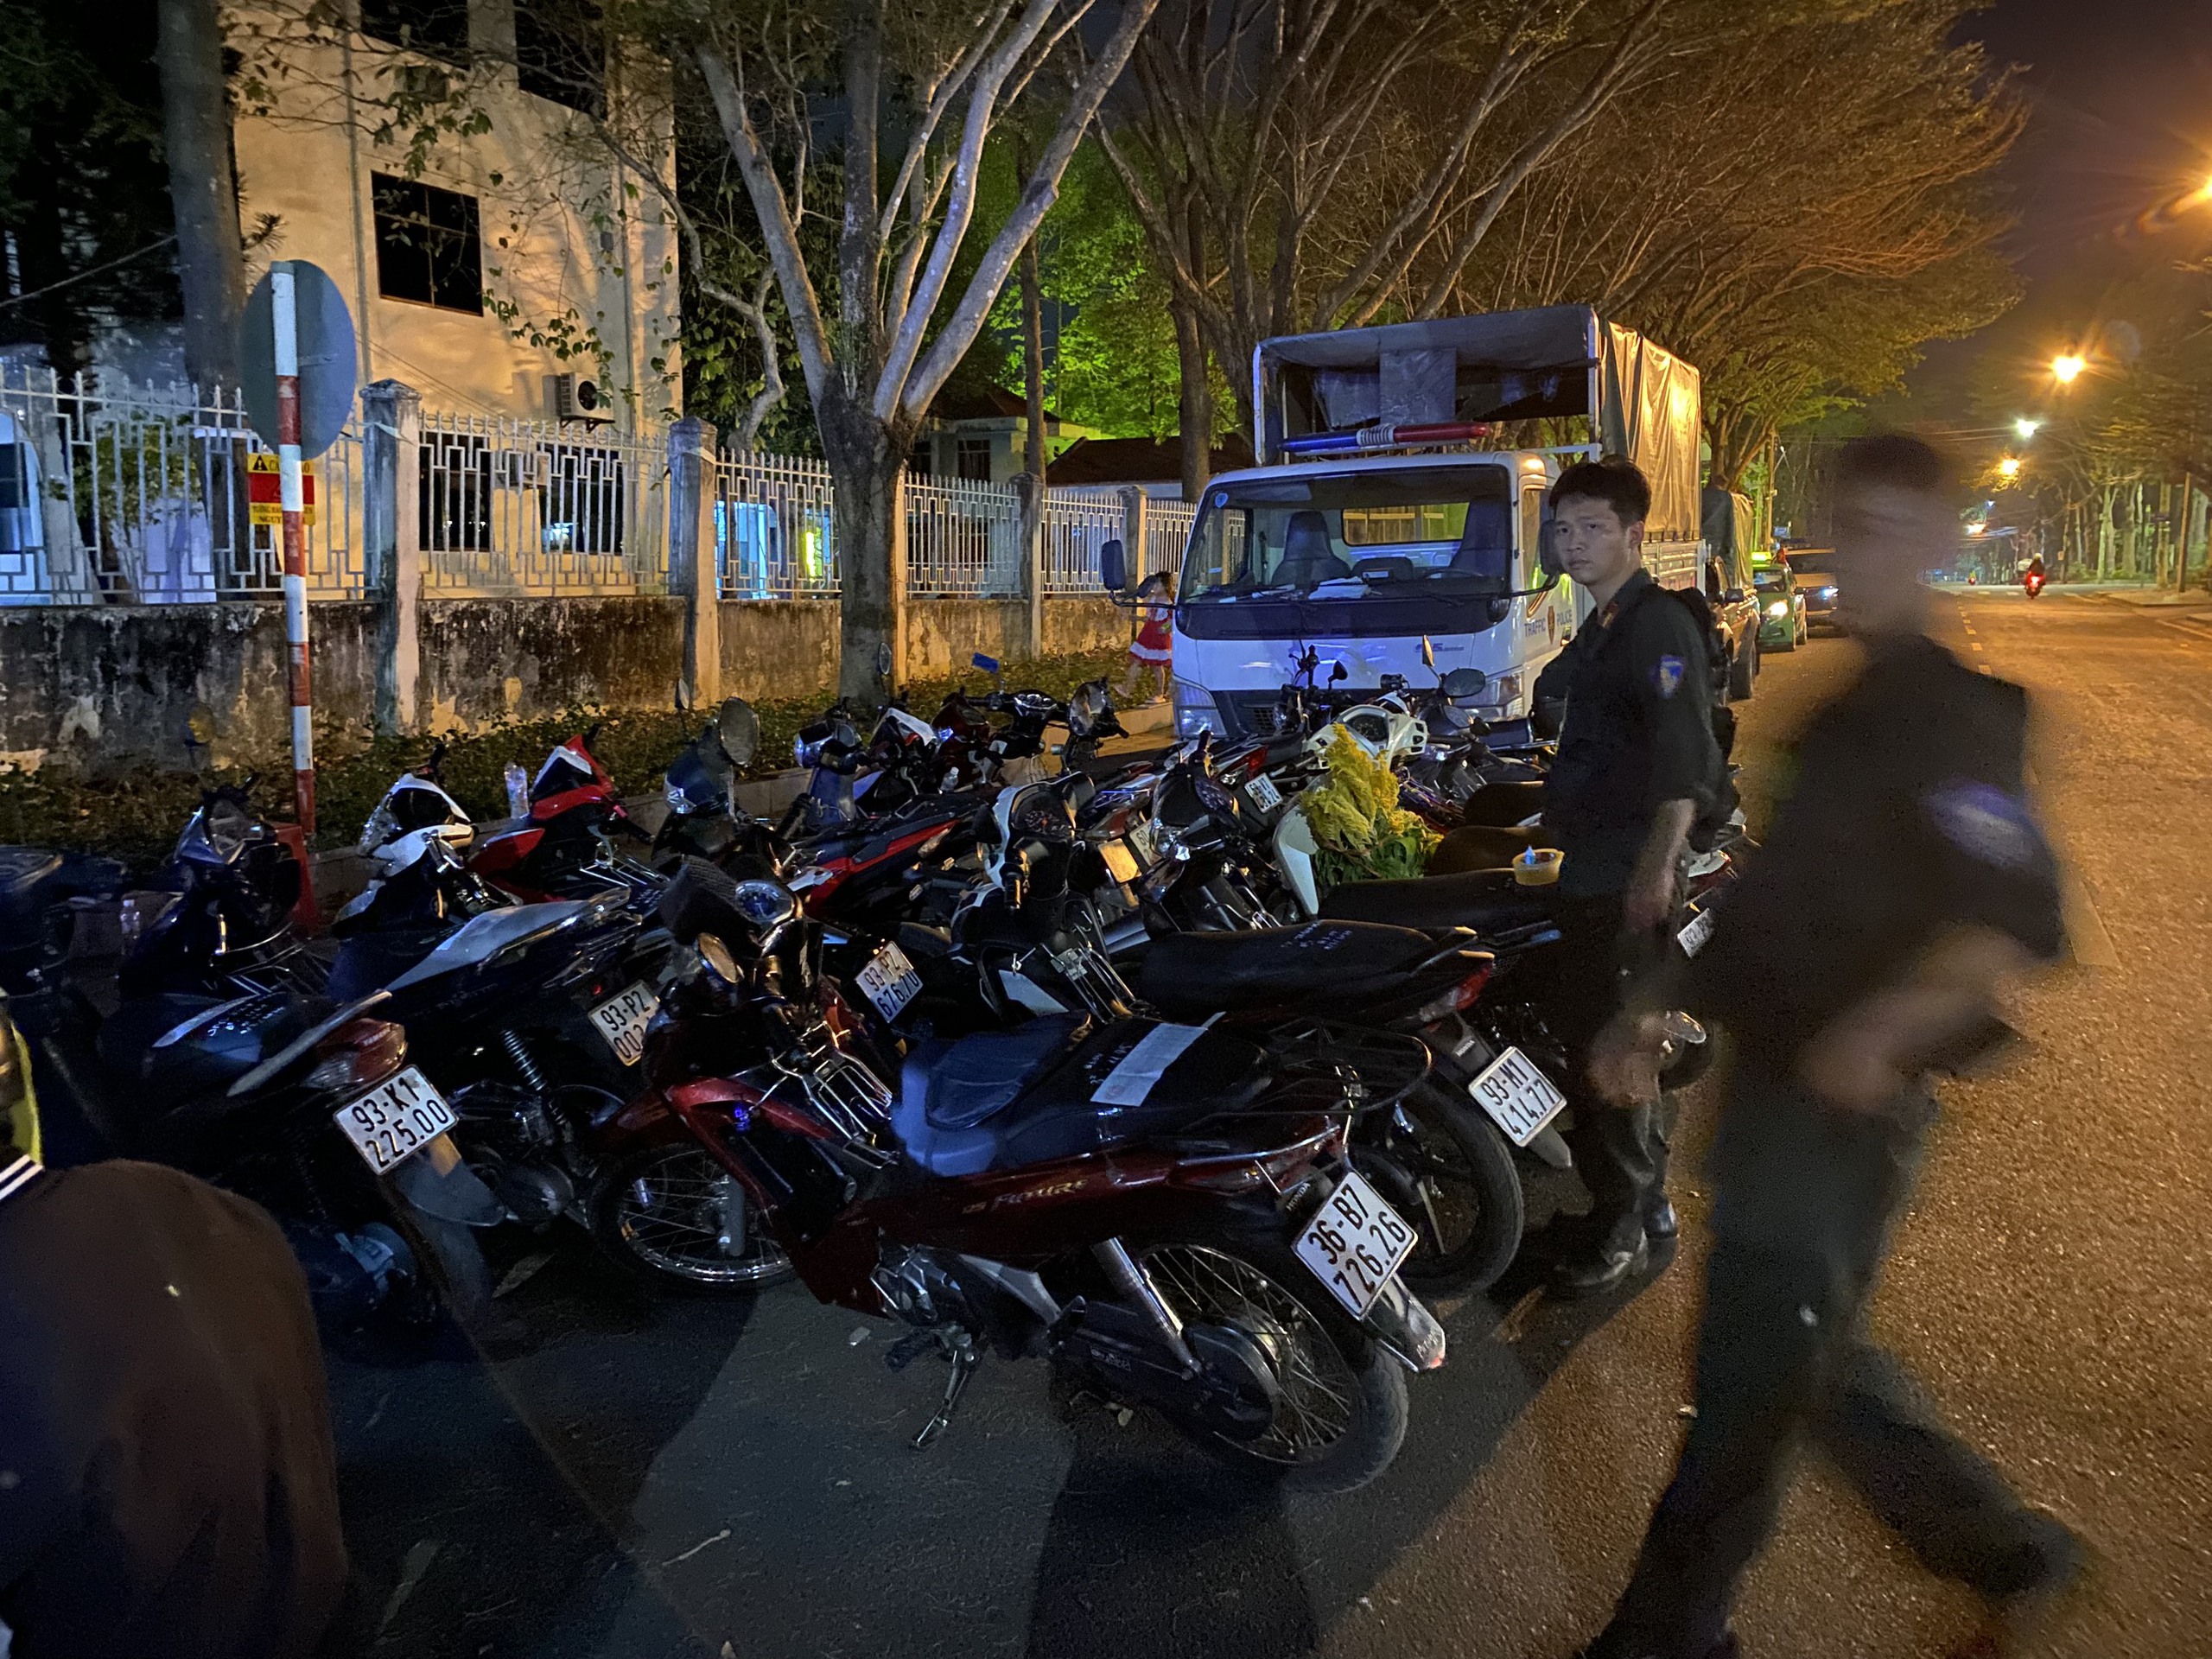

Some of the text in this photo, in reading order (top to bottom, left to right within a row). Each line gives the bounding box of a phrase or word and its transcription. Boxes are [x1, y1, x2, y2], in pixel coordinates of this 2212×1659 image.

[1557, 609, 1573, 626] POLICE
[352, 1077, 420, 1132] 93-K1
[365, 1099, 448, 1167] 225.00
[1500, 1078, 1555, 1135] 414.77
[1286, 1182, 1311, 1211] HONDA
[1307, 1183, 1370, 1265] 36-B7
[1332, 1211, 1407, 1308] 726.26
